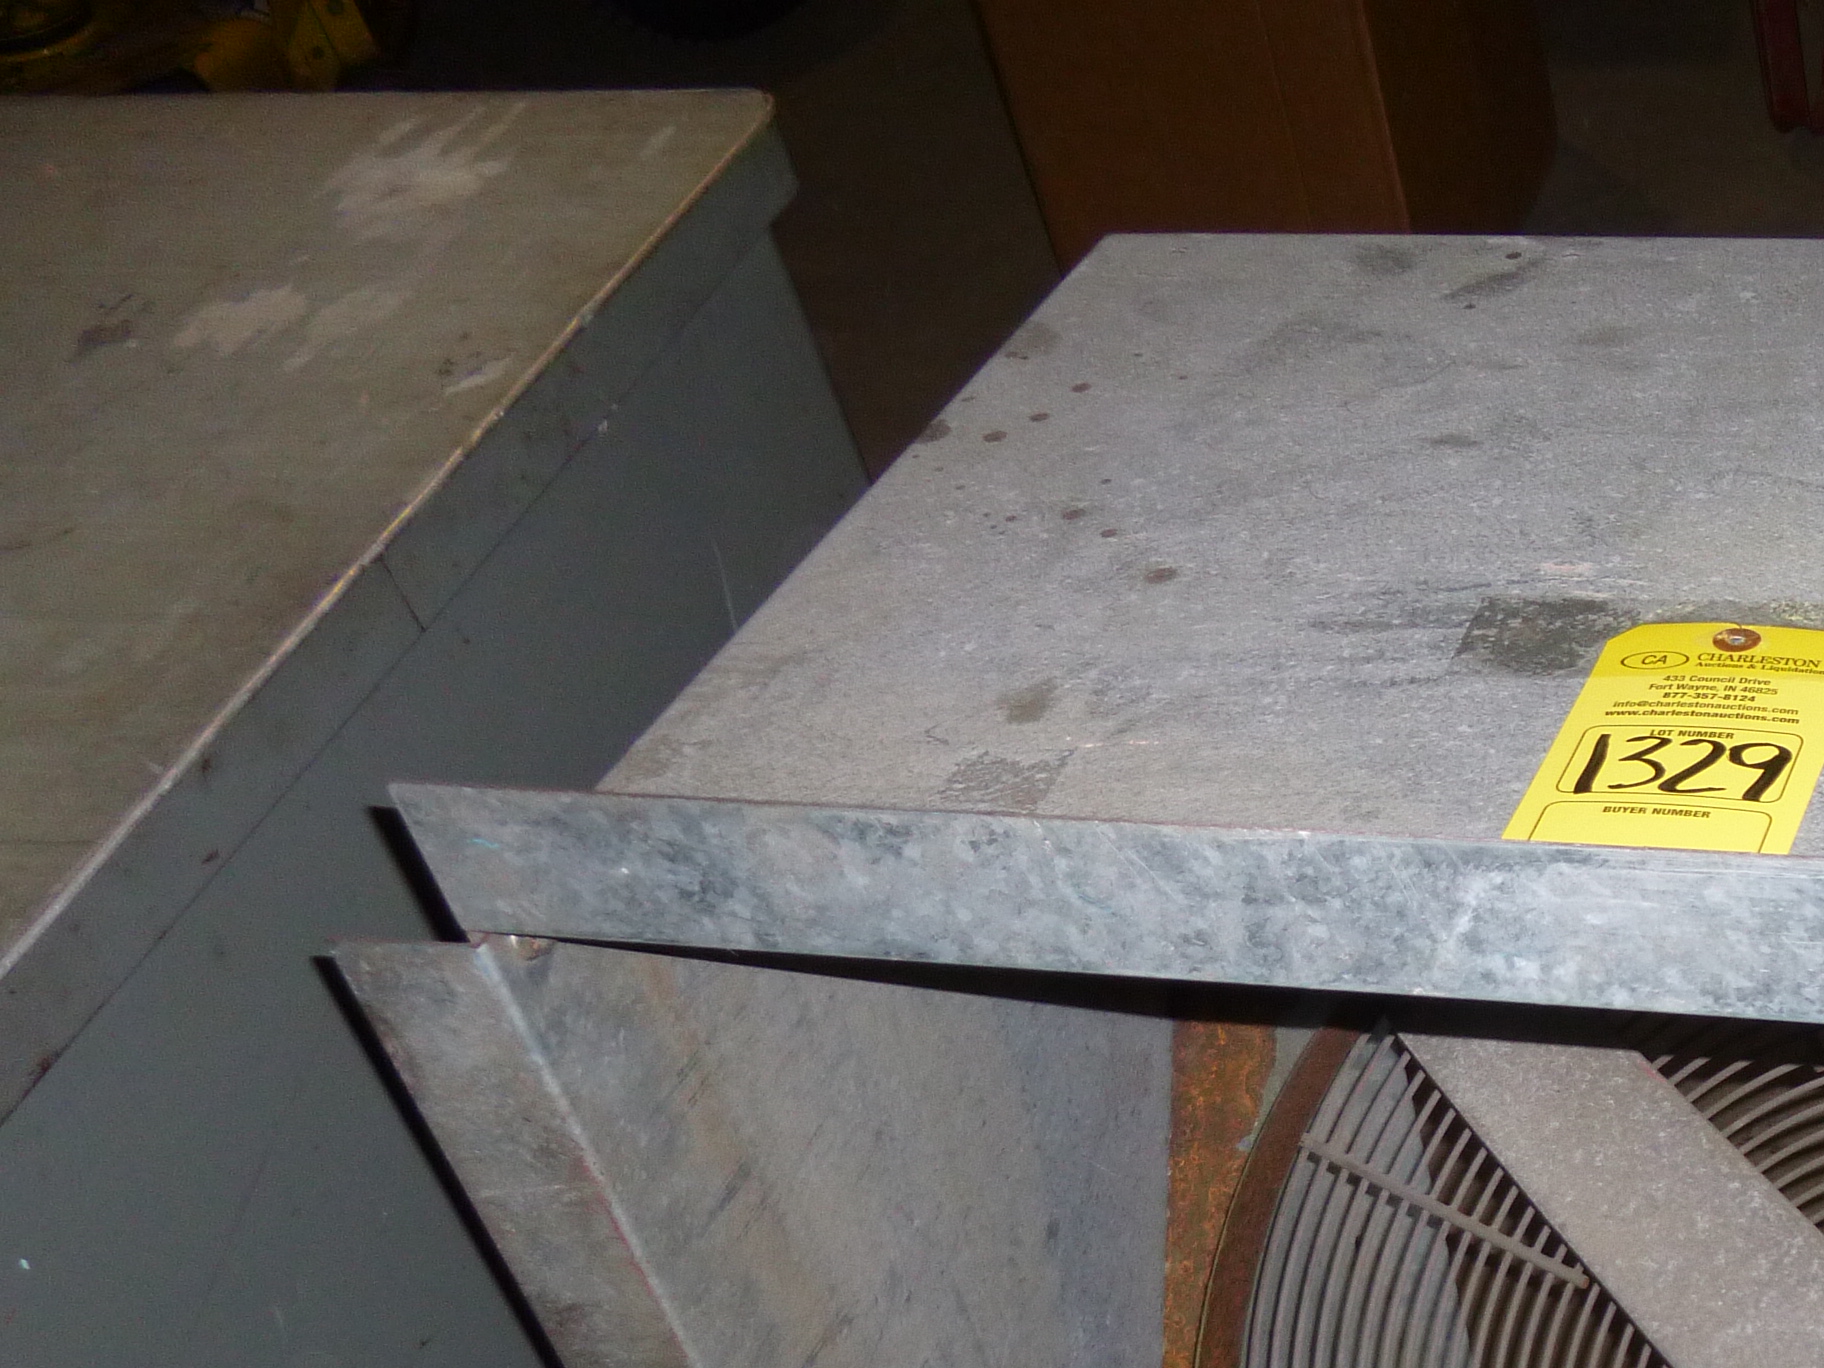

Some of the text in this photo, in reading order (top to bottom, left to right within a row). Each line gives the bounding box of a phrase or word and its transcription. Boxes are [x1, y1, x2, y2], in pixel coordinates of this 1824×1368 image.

[1641, 655, 1668, 665] CA
[1695, 661, 1744, 670] Auctions
[1697, 652, 1822, 668] CHARLESTON
[1689, 675, 1736, 684] Council
[1739, 677, 1771, 686] Drive
[1648, 683, 1778, 695] Fort Wayne, IN 46825
[1662, 692, 1756, 702] 877-357-8124
[1613, 700, 1799, 715] info@charlestonauctions.com
[1605, 708, 1800, 724] www.charlestonauctions.com
[1650, 729, 1735, 740] LOT NUMBER
[1573, 734, 1792, 802] 1329
[1602, 805, 1712, 819] BUYER NUMBER
